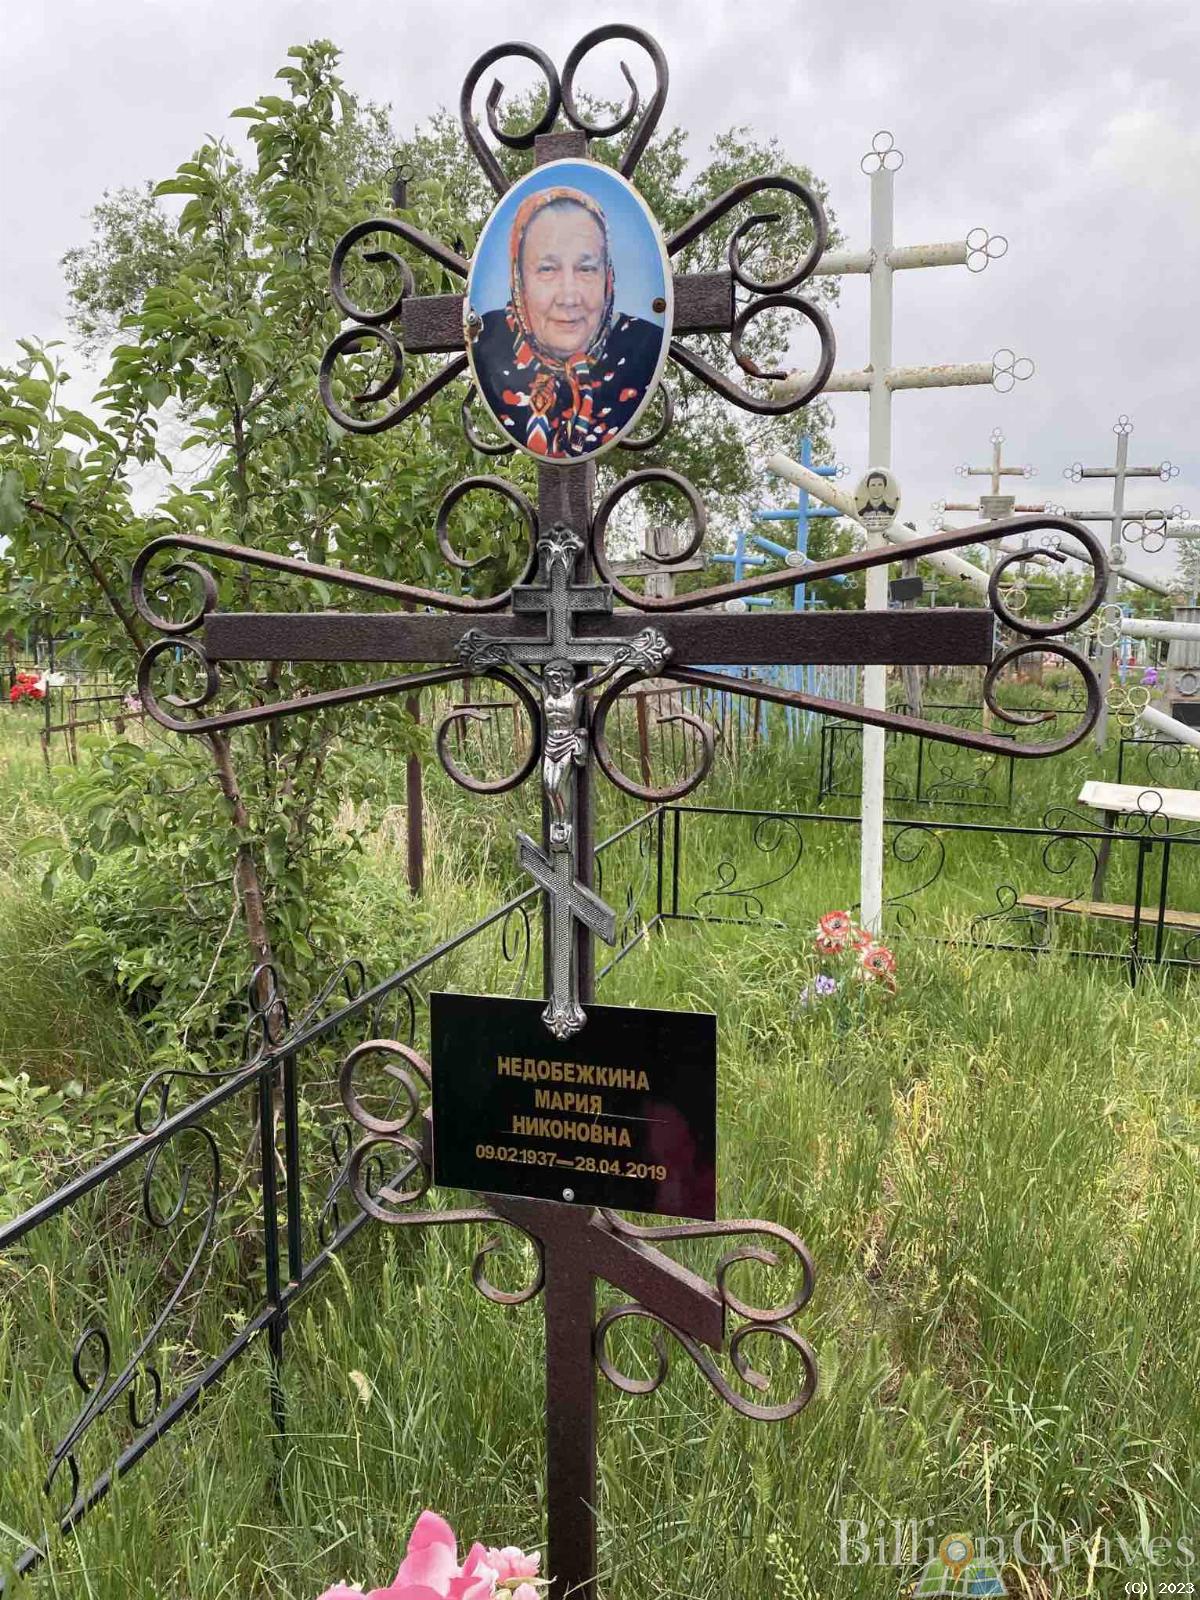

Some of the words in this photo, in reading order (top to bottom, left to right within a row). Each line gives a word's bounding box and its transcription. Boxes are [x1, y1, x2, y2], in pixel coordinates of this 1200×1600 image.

[497, 1056, 650, 1091] НЕДОБЕЖКИНА
[535, 1089, 602, 1115] МАРИЯ
[512, 1115, 632, 1148] НИКОНОВНА
